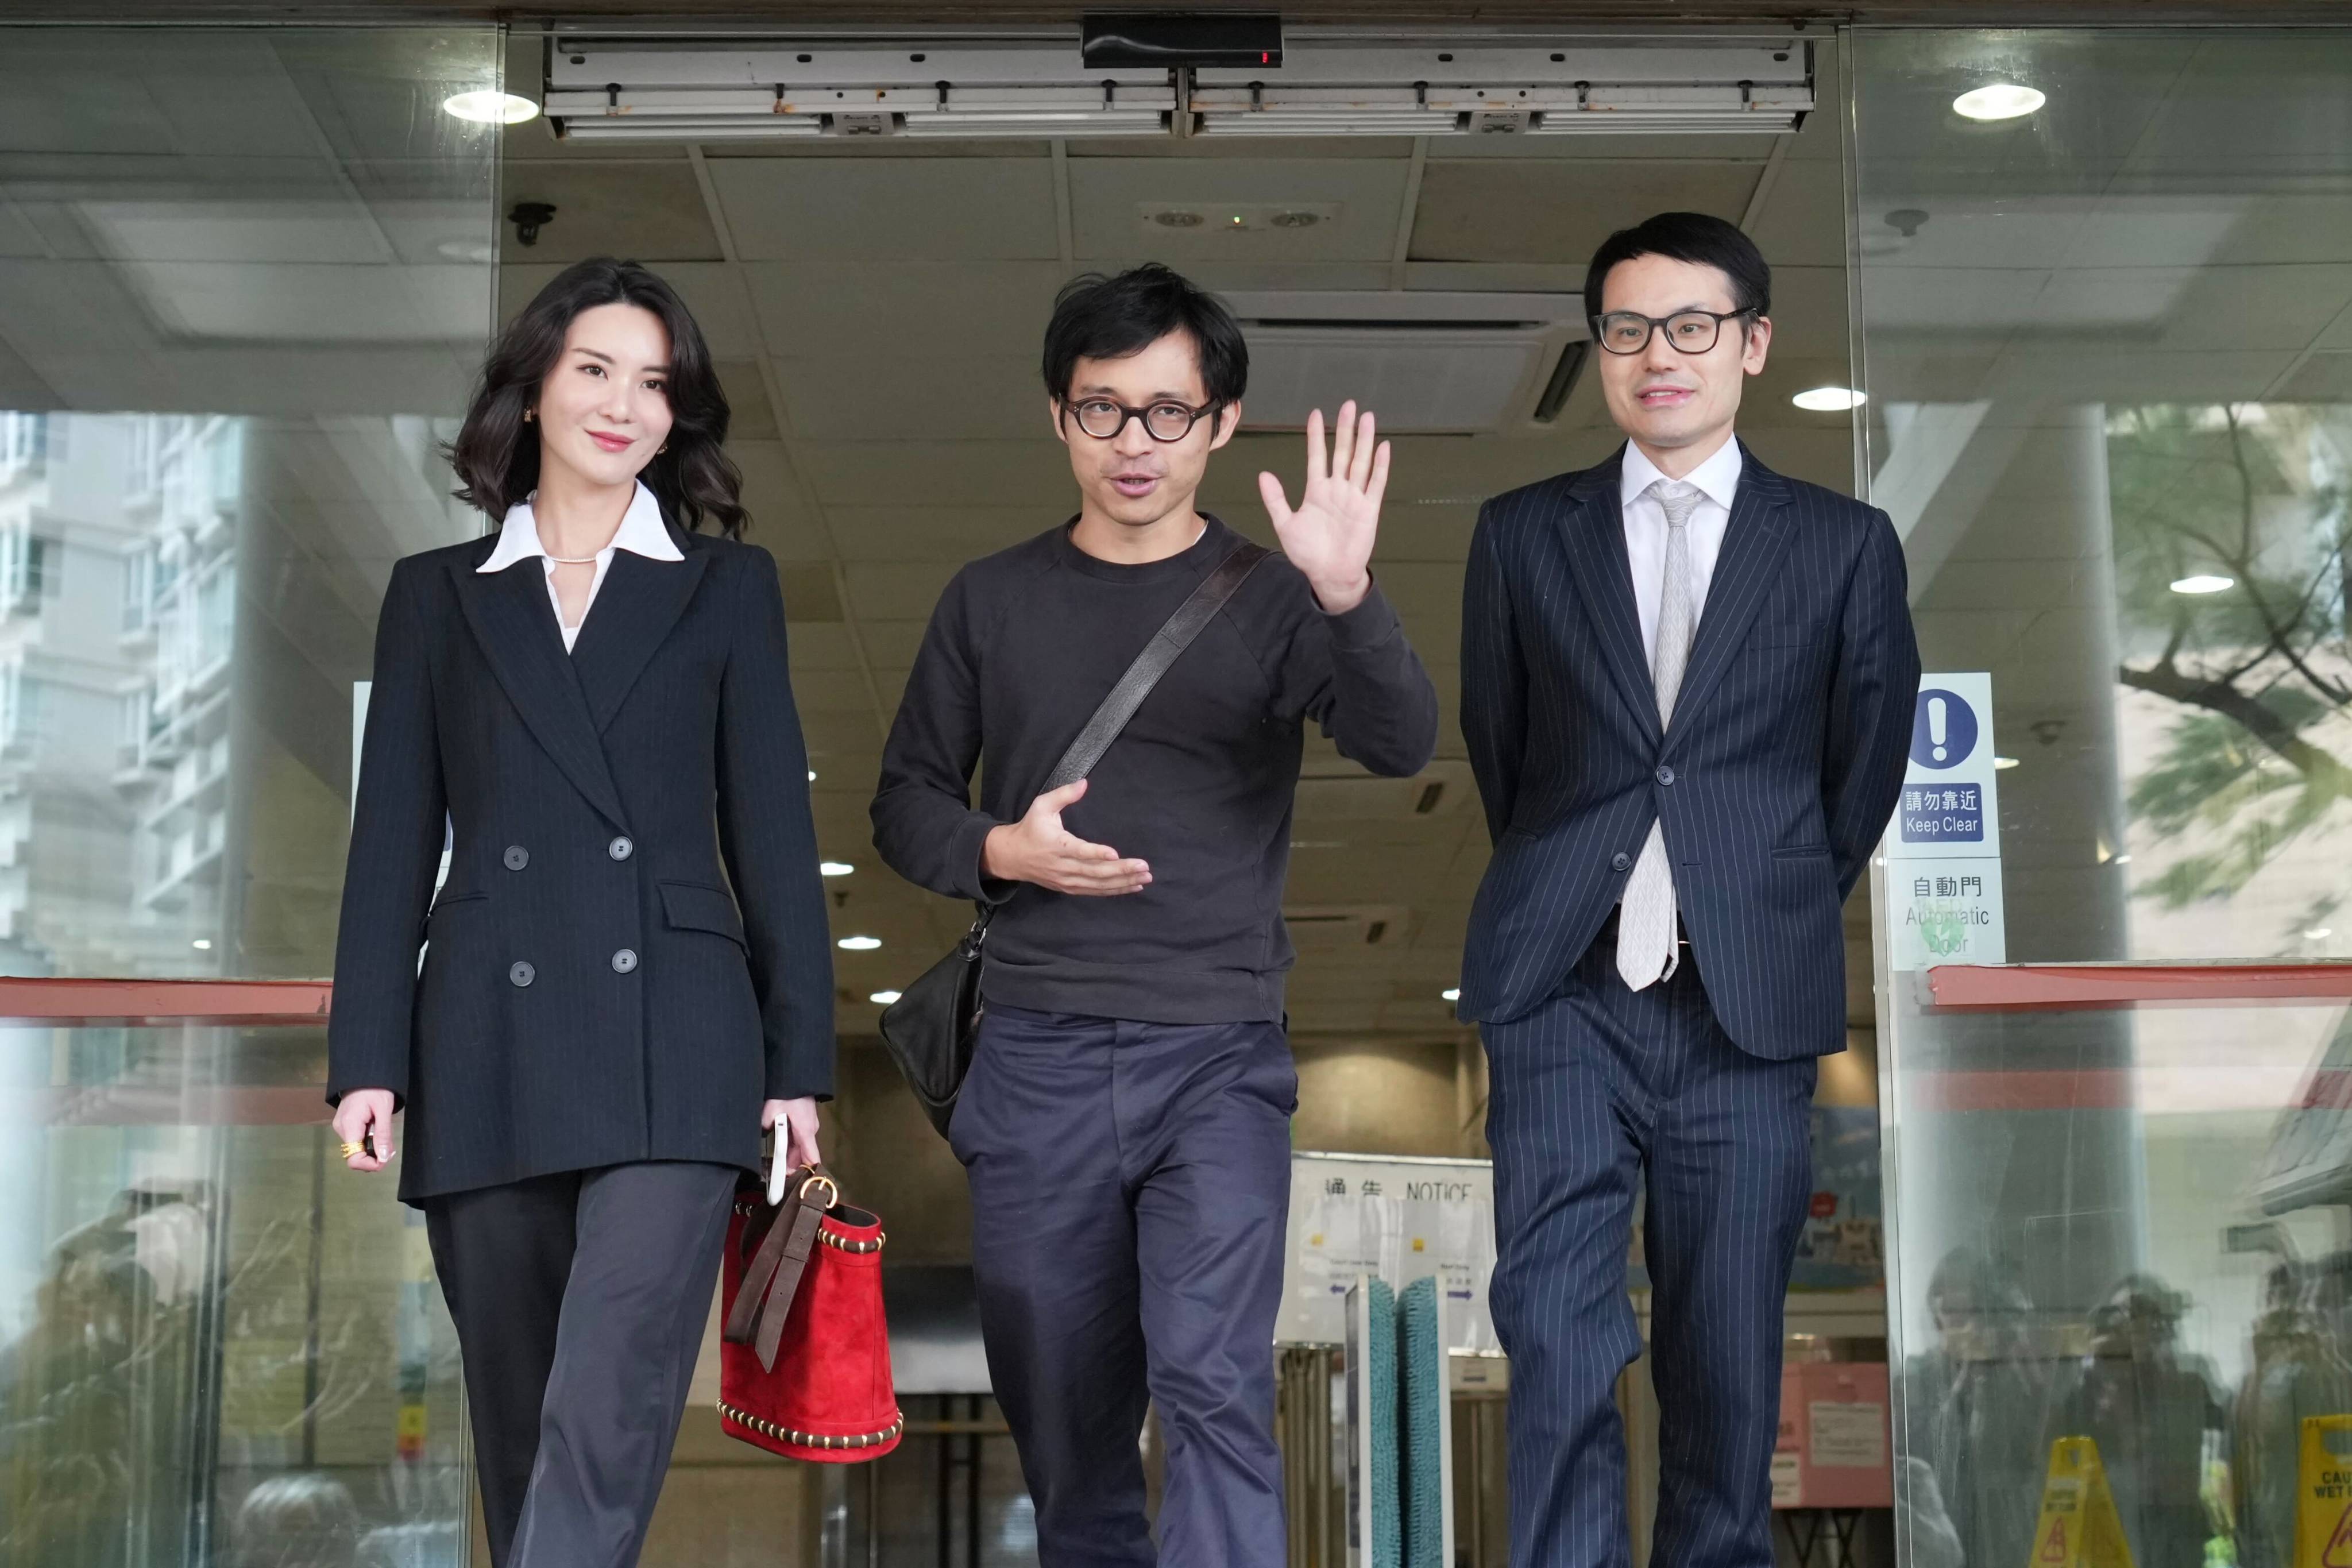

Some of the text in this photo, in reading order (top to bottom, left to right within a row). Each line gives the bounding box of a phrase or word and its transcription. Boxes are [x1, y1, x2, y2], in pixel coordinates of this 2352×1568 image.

[1905, 790, 1977, 811] 請勿靠近
[1906, 816, 1978, 836] Keep Clear
[1914, 876, 1982, 897] 自動門
